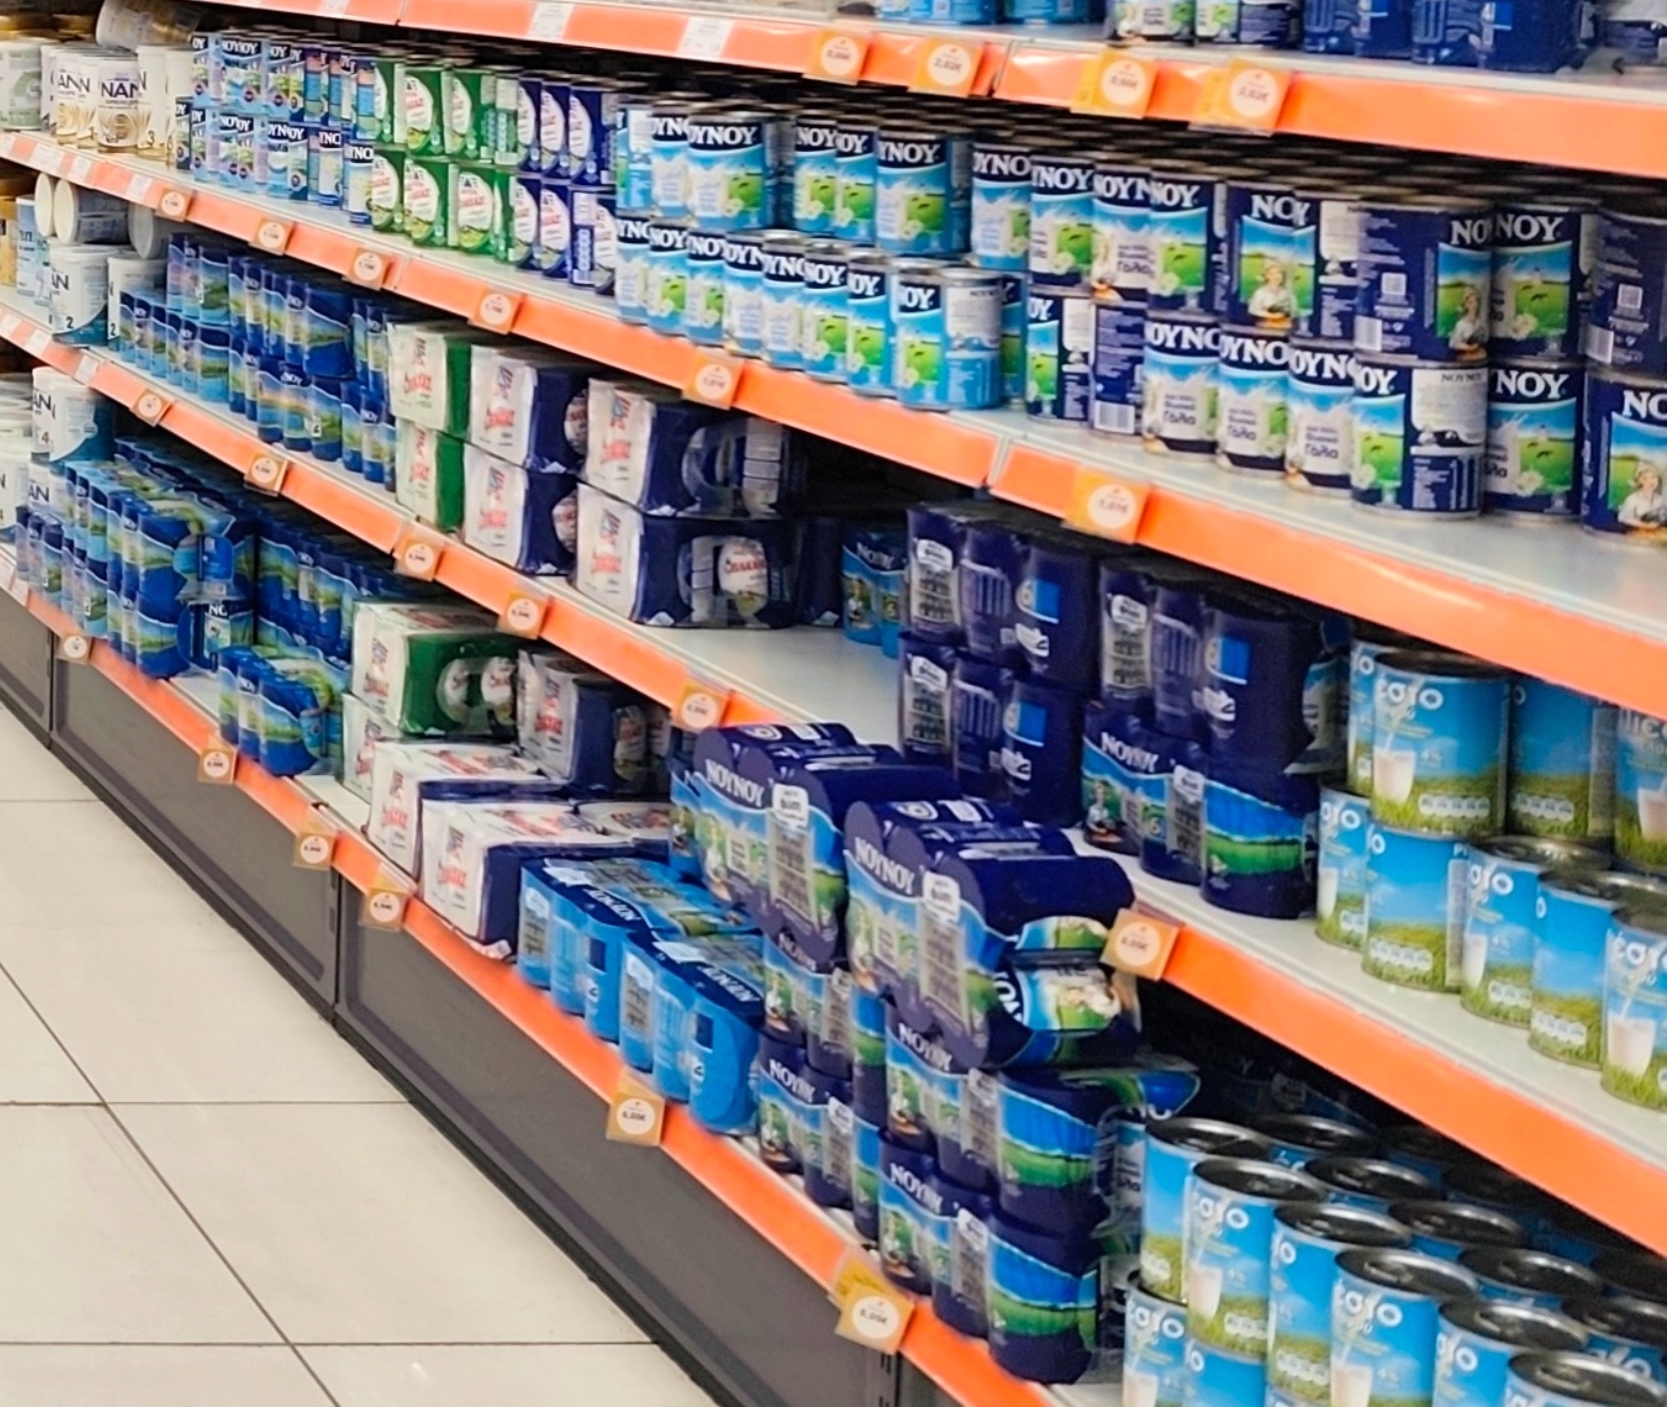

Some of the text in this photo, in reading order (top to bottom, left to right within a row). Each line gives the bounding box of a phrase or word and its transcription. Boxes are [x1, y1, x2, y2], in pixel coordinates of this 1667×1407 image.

[101, 82, 139, 98] NAN
[689, 126, 758, 146] YNOY
[1497, 214, 1561, 243] NOY
[1147, 323, 1221, 351] OYNO
[1497, 369, 1569, 397] NOY
[707, 762, 765, 804] NOYNOY
[855, 839, 915, 892] NOYNOY
